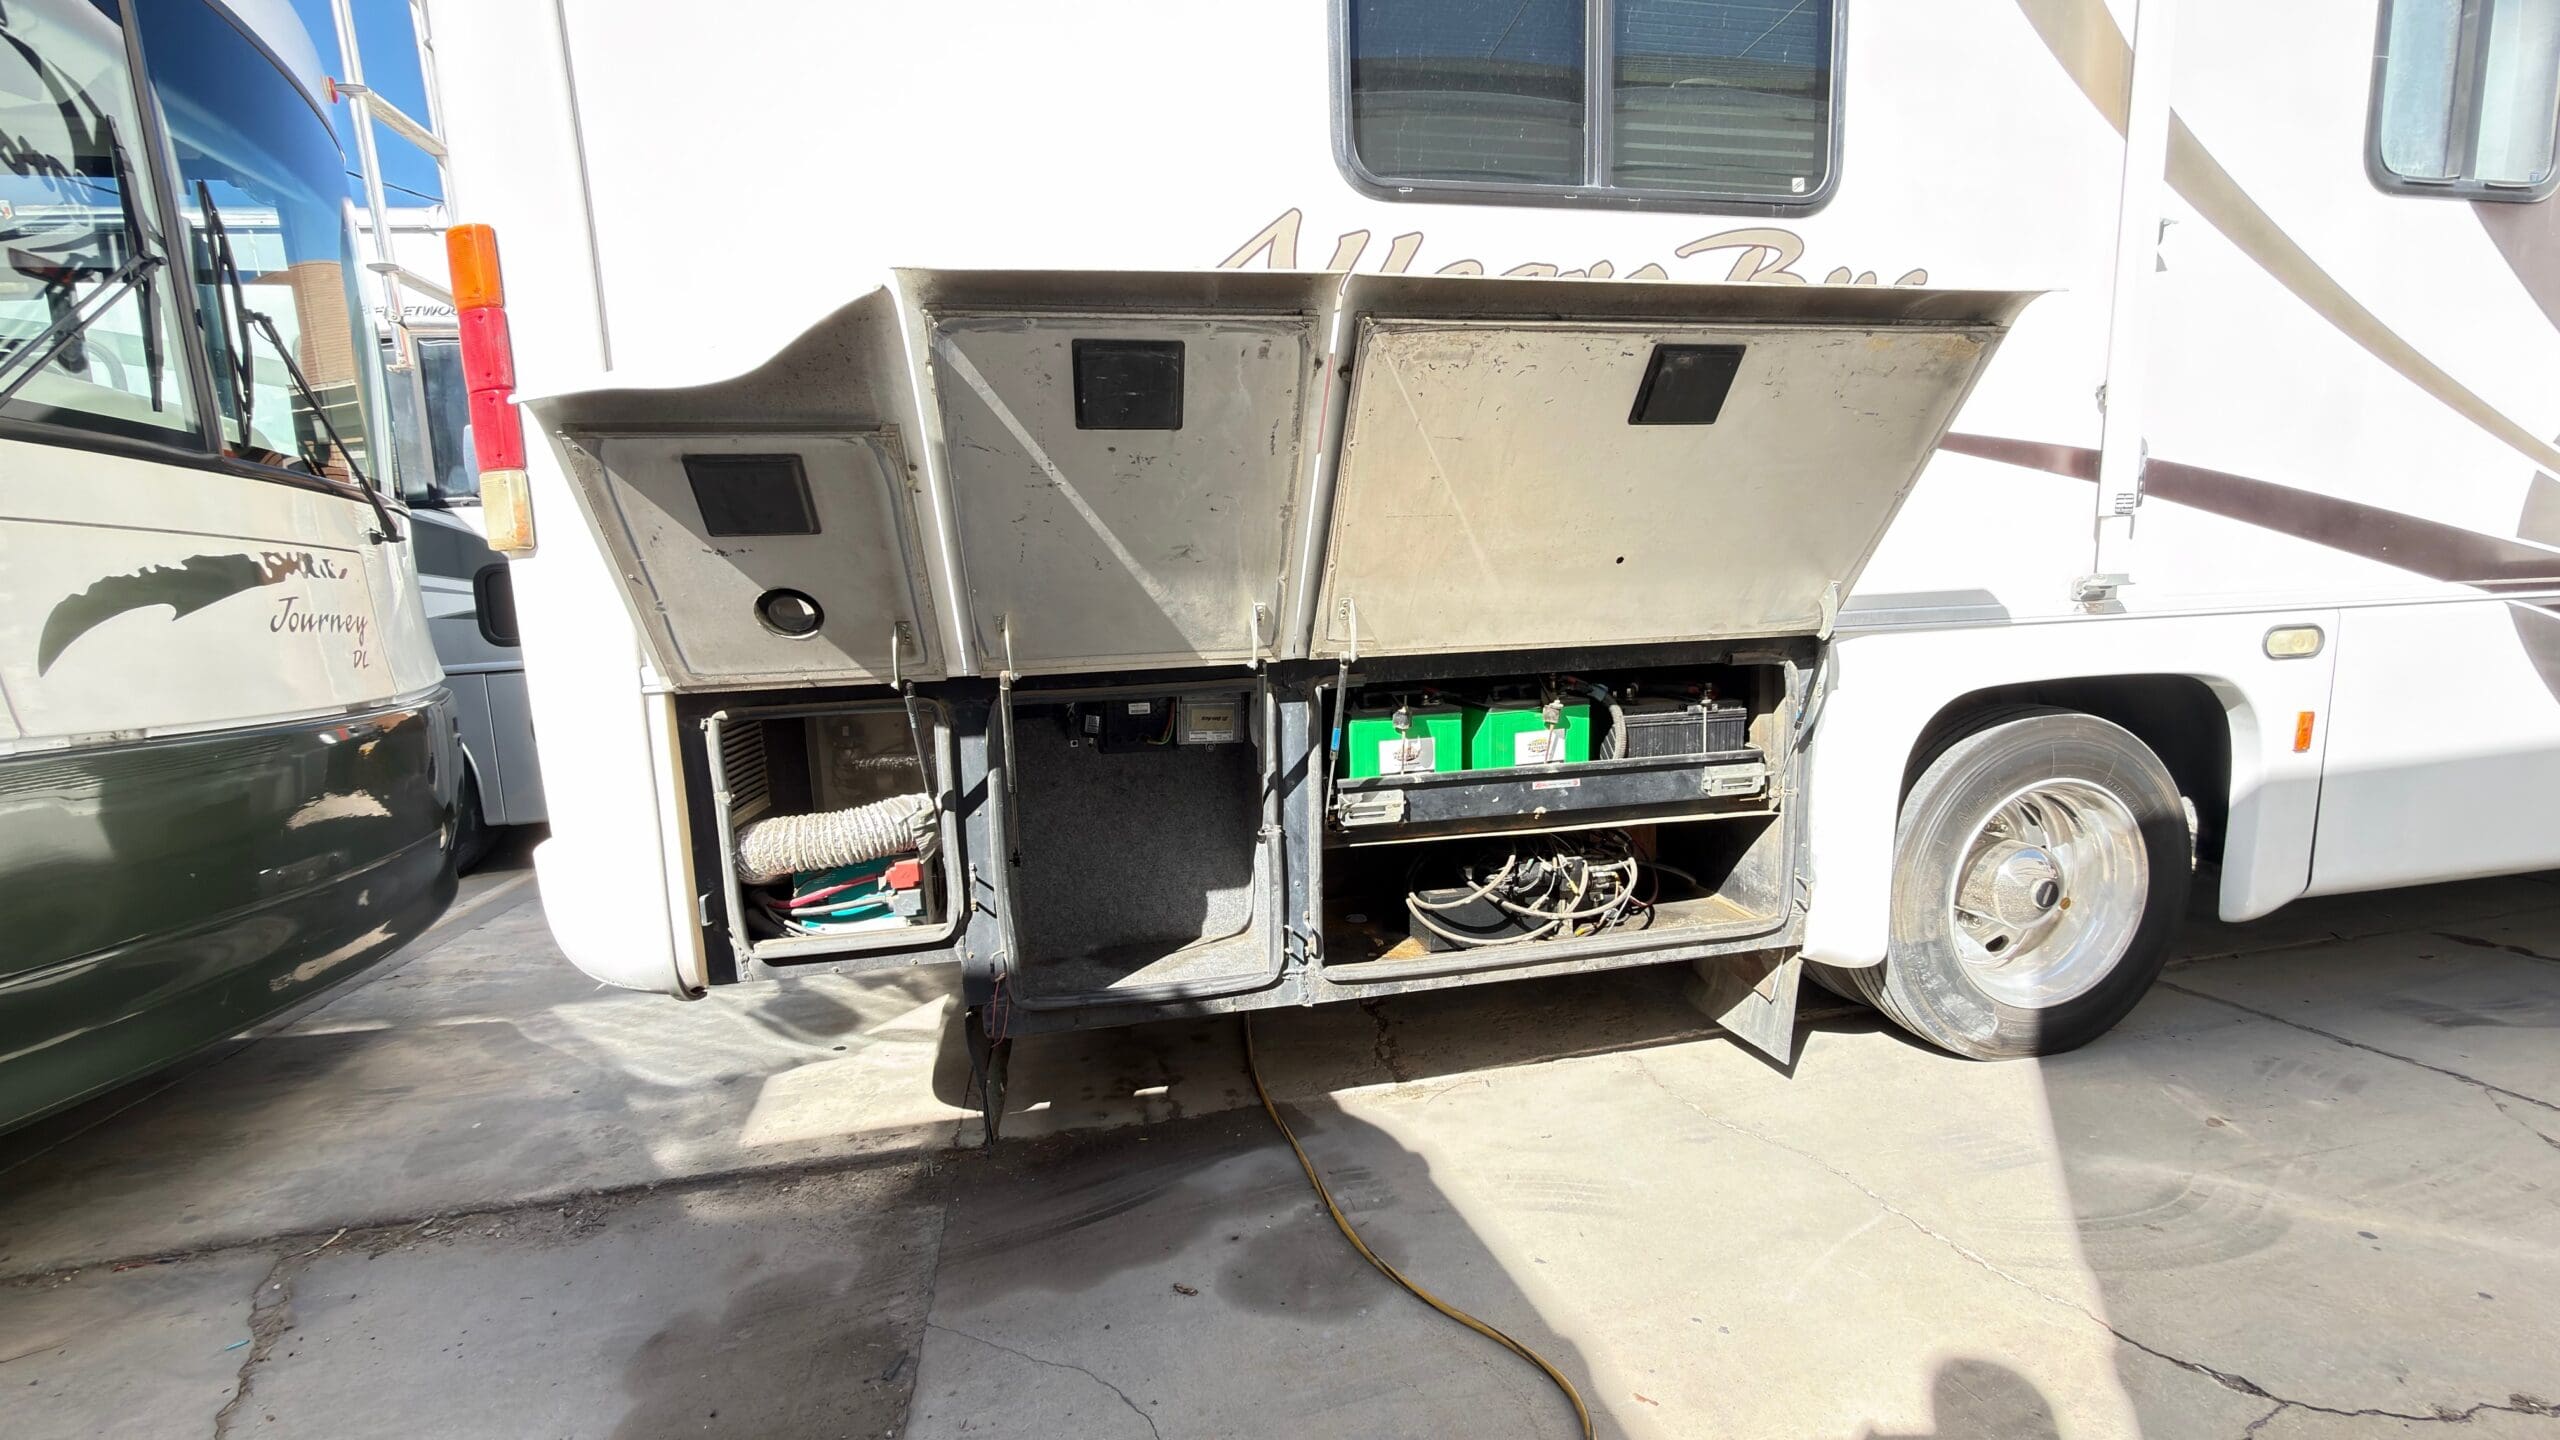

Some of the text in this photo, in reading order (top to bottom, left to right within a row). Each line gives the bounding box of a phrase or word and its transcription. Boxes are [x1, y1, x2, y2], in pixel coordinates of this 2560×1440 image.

[374, 304, 458, 317] FETWO
[269, 596, 368, 647] Journey
[352, 649, 370, 669] DL
